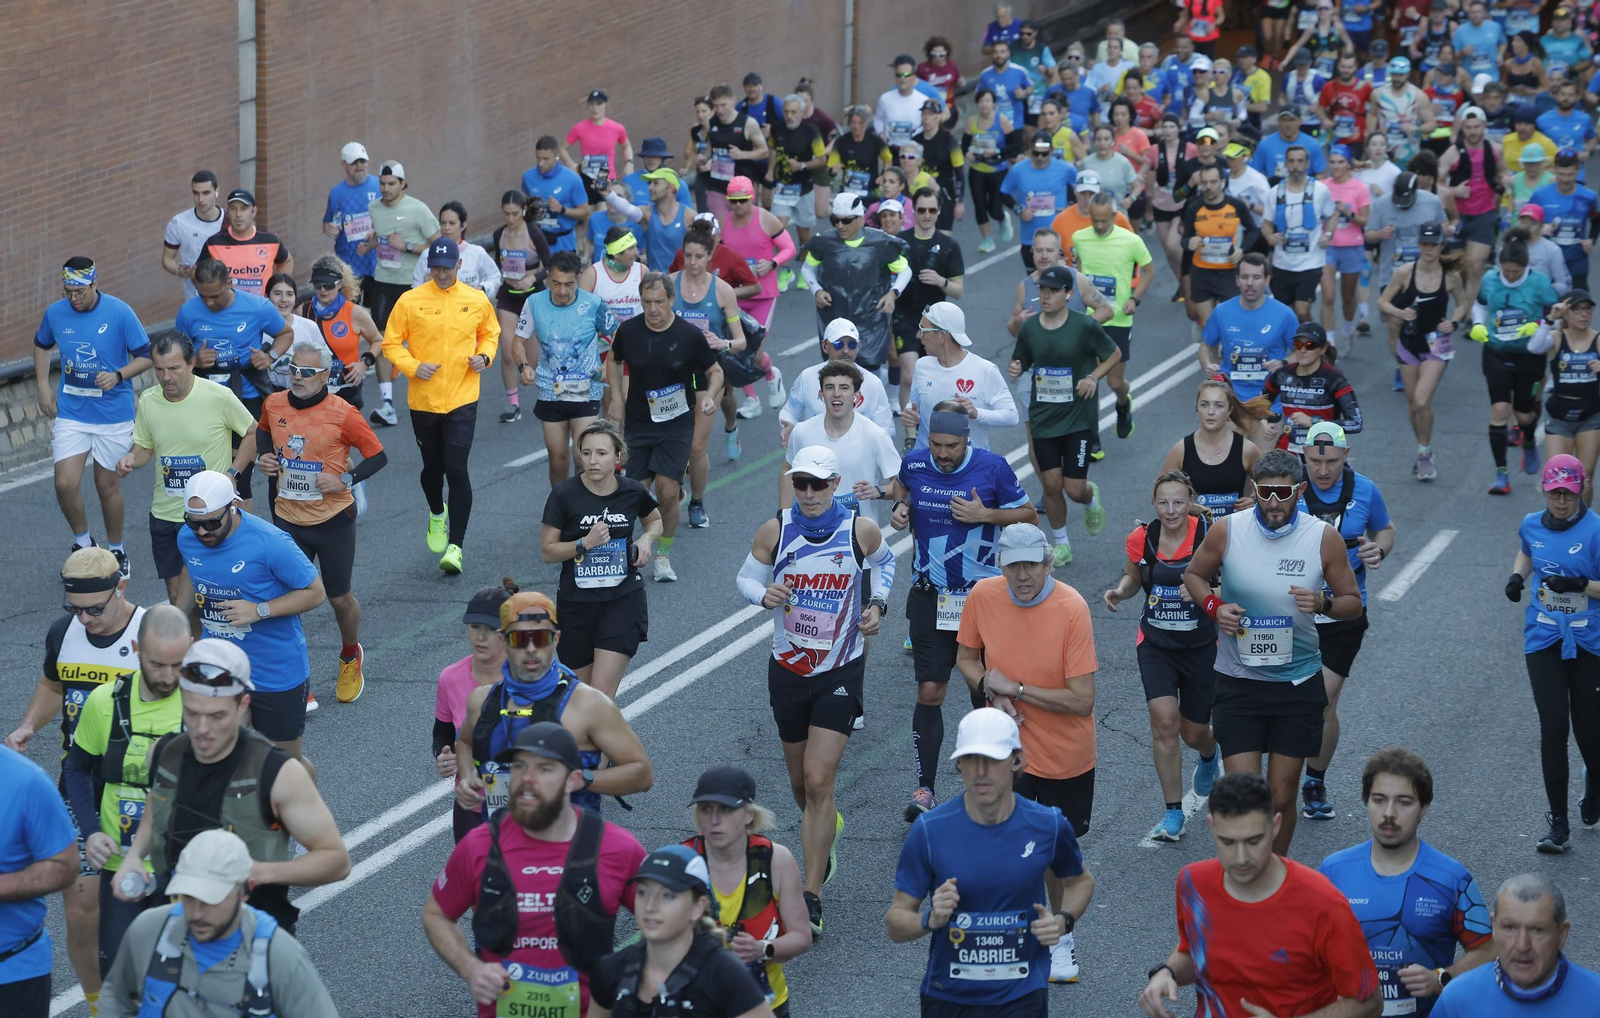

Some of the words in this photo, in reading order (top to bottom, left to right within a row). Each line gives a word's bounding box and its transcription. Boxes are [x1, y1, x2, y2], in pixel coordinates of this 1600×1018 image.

[1236, 363, 1263, 371] EMILIO
[660, 385, 682, 397] ZURICH
[1280, 385, 1297, 394] SAN
[1298, 387, 1325, 395] PABLO
[660, 401, 679, 414] PAGU
[290, 461, 316, 471] ZURICH
[908, 462, 926, 470] HOKA
[168, 479, 182, 488] SIR
[933, 488, 967, 498] HYUNDAI
[1208, 495, 1234, 503] ZURICH
[590, 556, 611, 564] 13832
[209, 587, 237, 597] ZURICH
[802, 599, 833, 611] ZURICH
[800, 613, 816, 623] 9564
[1154, 610, 1190, 620] KARINE
[1254, 618, 1286, 626] ZURICH
[794, 623, 819, 637] BIGO
[1253, 633, 1275, 641] 11950
[1250, 643, 1278, 653] ESPO
[976, 916, 1018, 926] ZURICH
[975, 936, 1004, 946] 13406
[959, 949, 1020, 963] GABRIEL
[527, 970, 569, 983] ZURICH
[526, 991, 551, 1002] 2315
